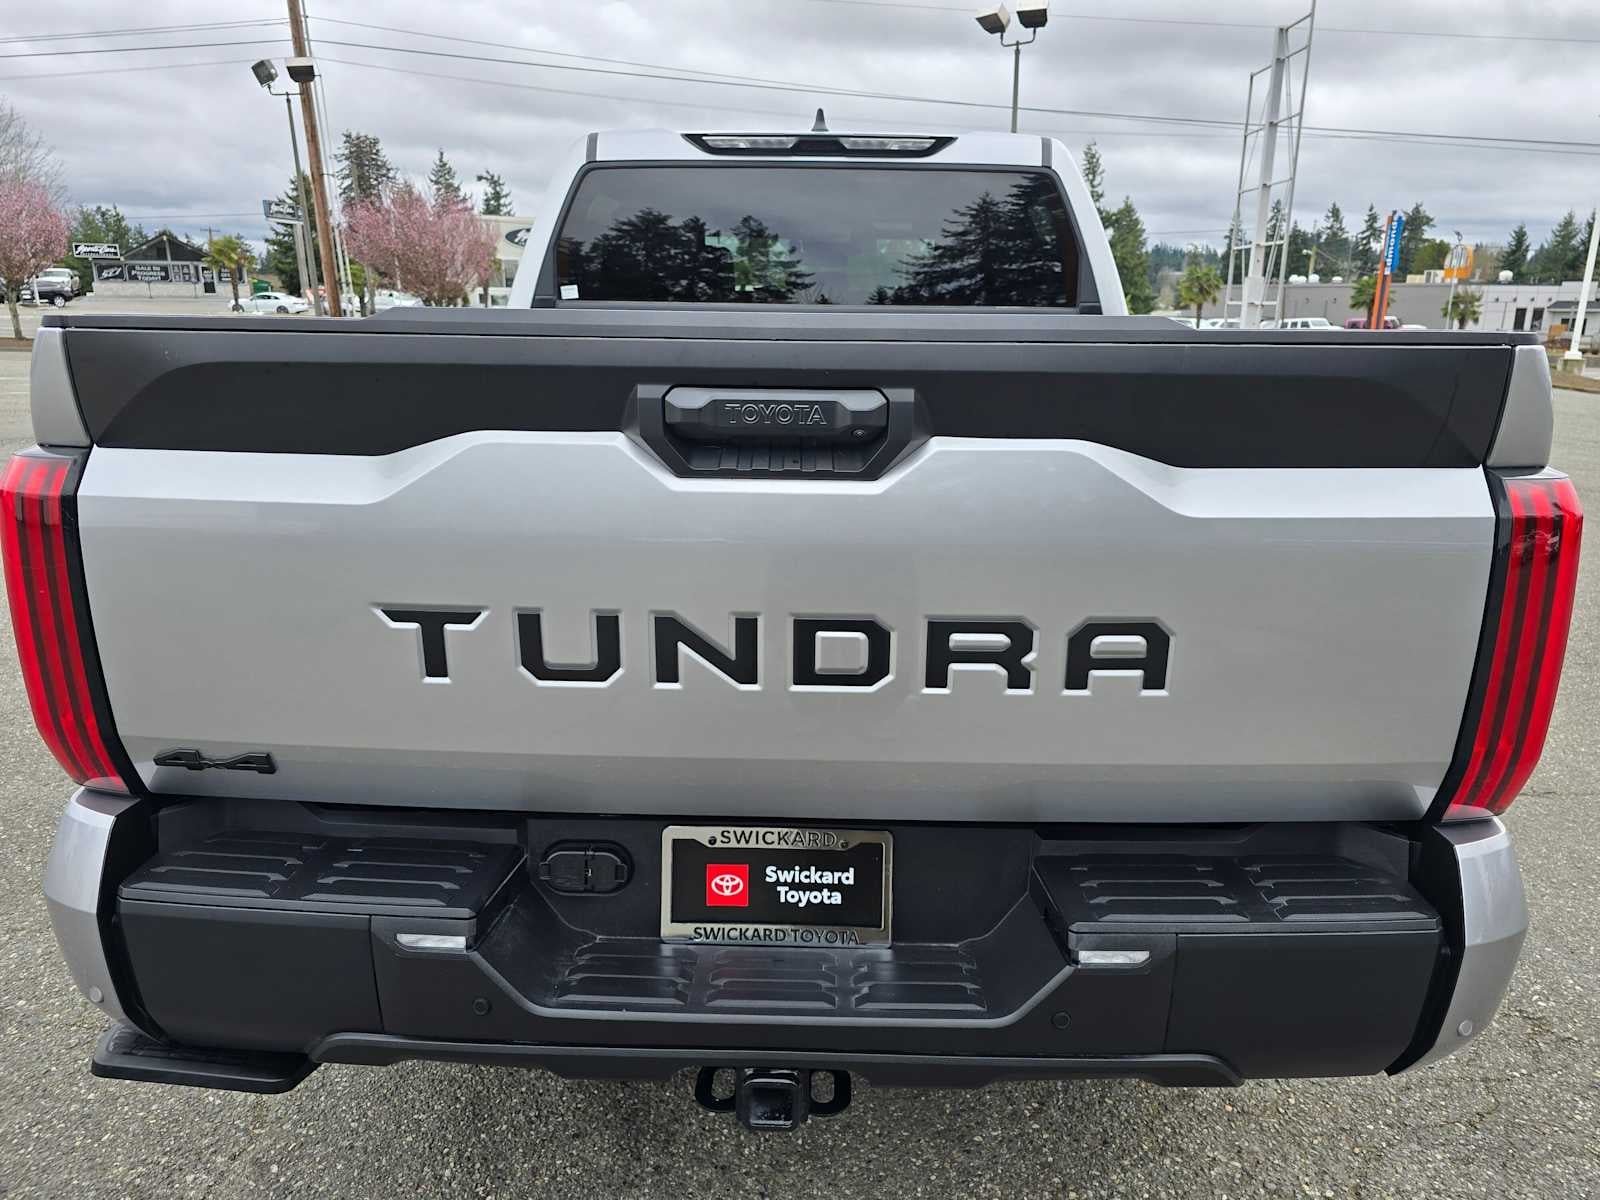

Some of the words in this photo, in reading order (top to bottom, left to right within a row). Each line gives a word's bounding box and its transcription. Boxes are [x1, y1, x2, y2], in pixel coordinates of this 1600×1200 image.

[725, 403, 827, 424] TOYOTA
[371, 604, 1176, 698] TUNDRA
[720, 830, 837, 848] SWICKARD
[765, 866, 855, 885] Swickard
[777, 886, 842, 907] Toyota
[693, 927, 787, 942] SWICKARD
[790, 929, 859, 944] TOYOTA
